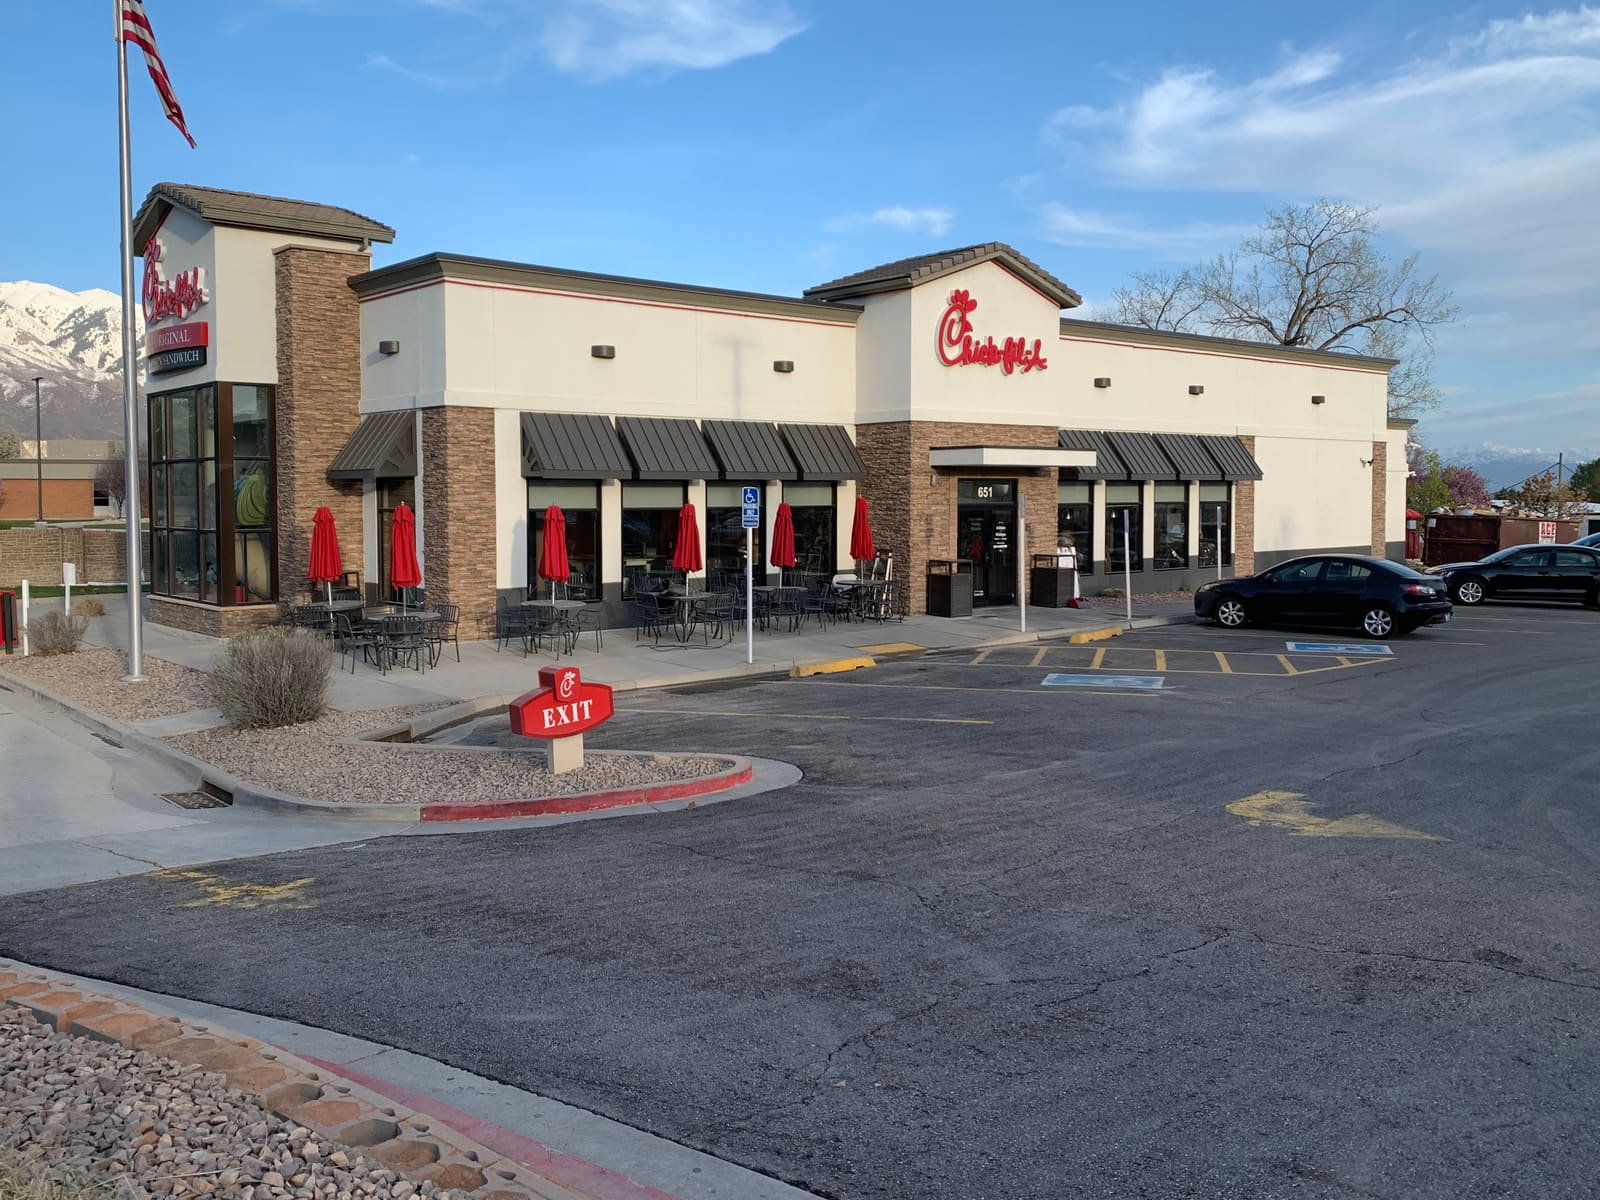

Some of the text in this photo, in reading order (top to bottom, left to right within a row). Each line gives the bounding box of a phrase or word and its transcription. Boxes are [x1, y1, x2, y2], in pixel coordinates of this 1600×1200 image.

[156, 329, 191, 347] RIGINAL
[938, 289, 1048, 375] Chick-fil-A
[977, 486, 993, 498] 651
[541, 699, 593, 729] EXIT
